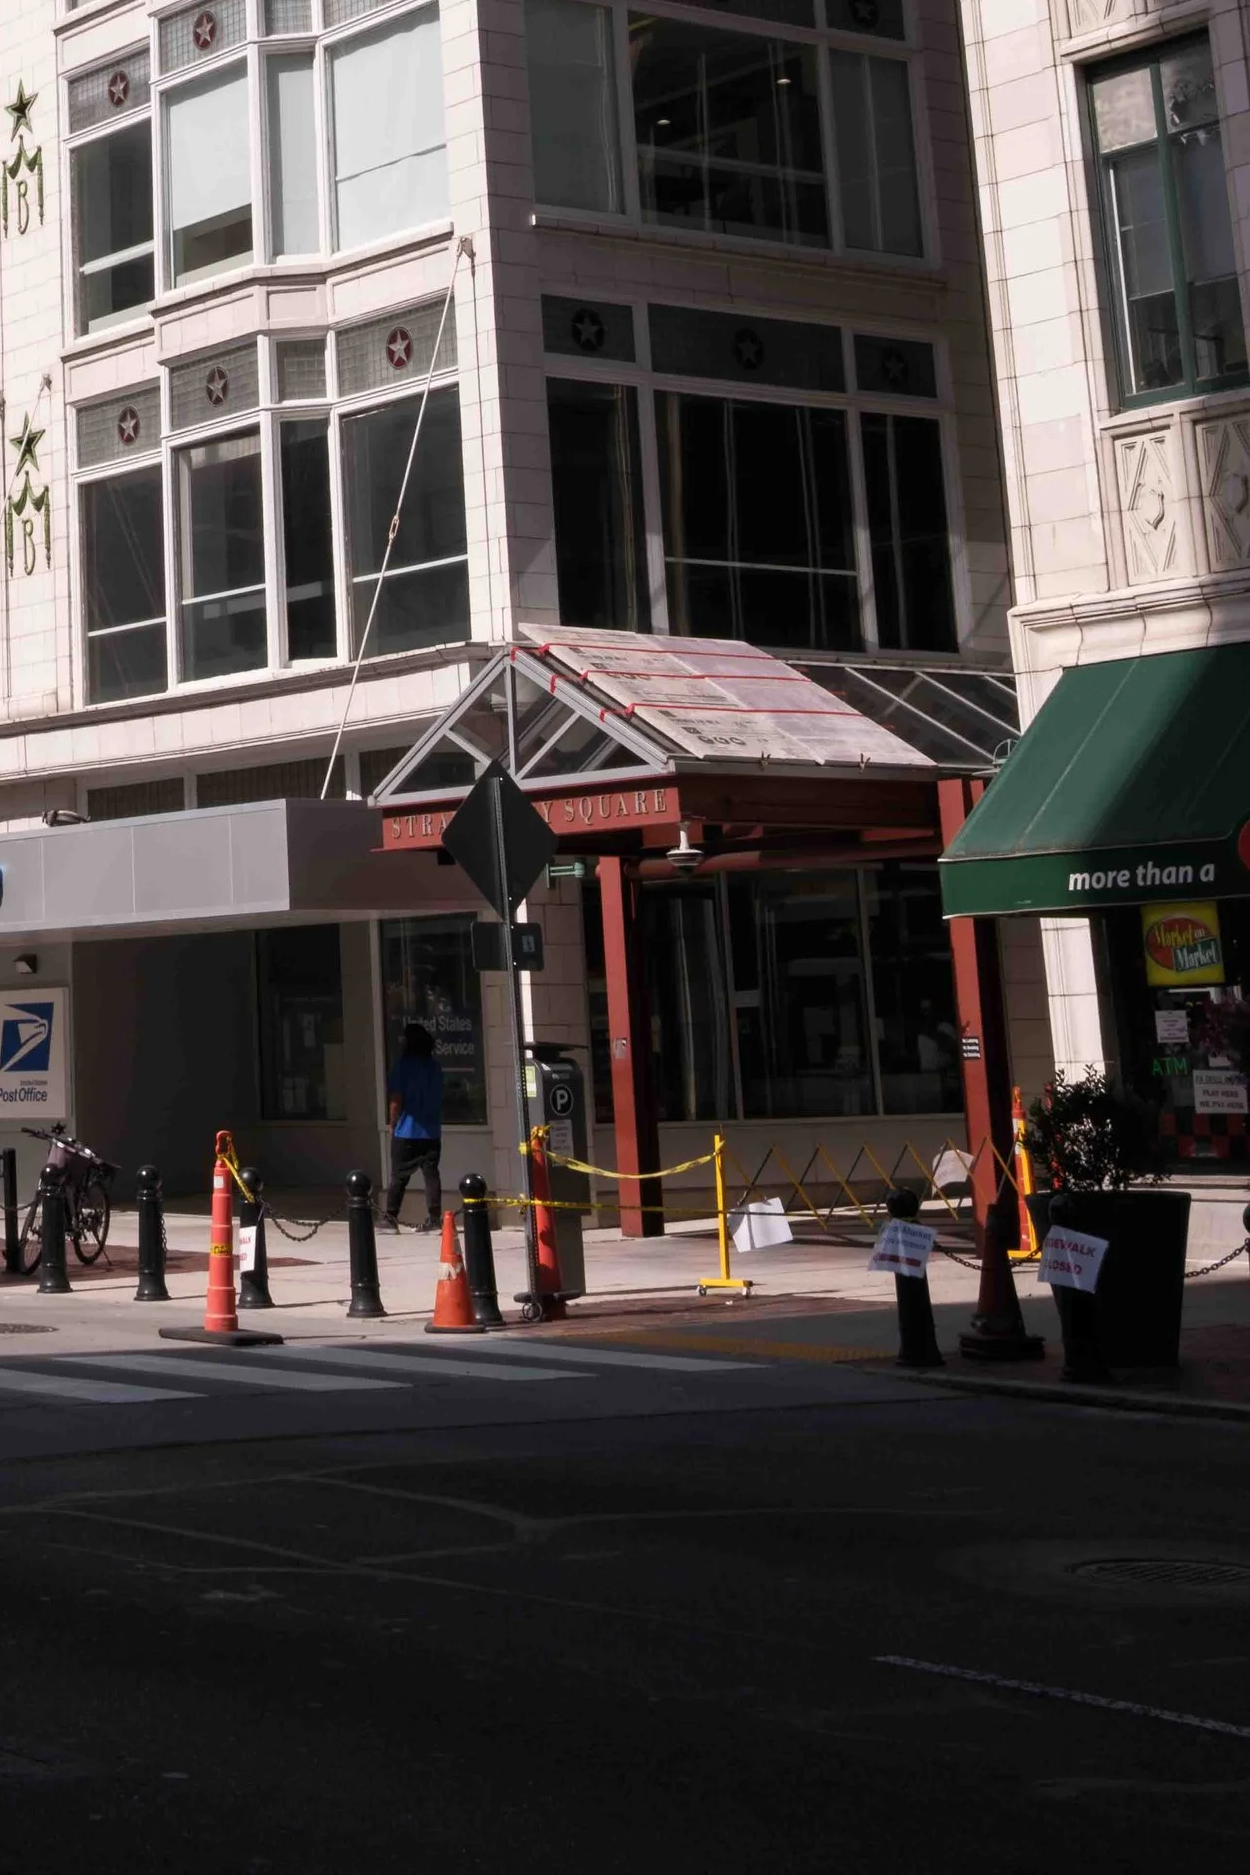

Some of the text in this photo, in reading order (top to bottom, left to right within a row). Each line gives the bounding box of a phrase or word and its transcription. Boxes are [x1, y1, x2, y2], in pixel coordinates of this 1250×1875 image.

[392, 788, 667, 839] STRAY SQUARE
[1068, 861, 1215, 892] more than a
[1154, 924, 1196, 948] Market
[1176, 941, 1217, 972] Market
[438, 1016, 473, 1032] States
[435, 1039, 475, 1055] Service
[1153, 1057, 1188, 1076] ATM
[556, 1089, 569, 1112] P
[1046, 1237, 1097, 1258] DEWALK
[1046, 1258, 1083, 1275] LOSED
